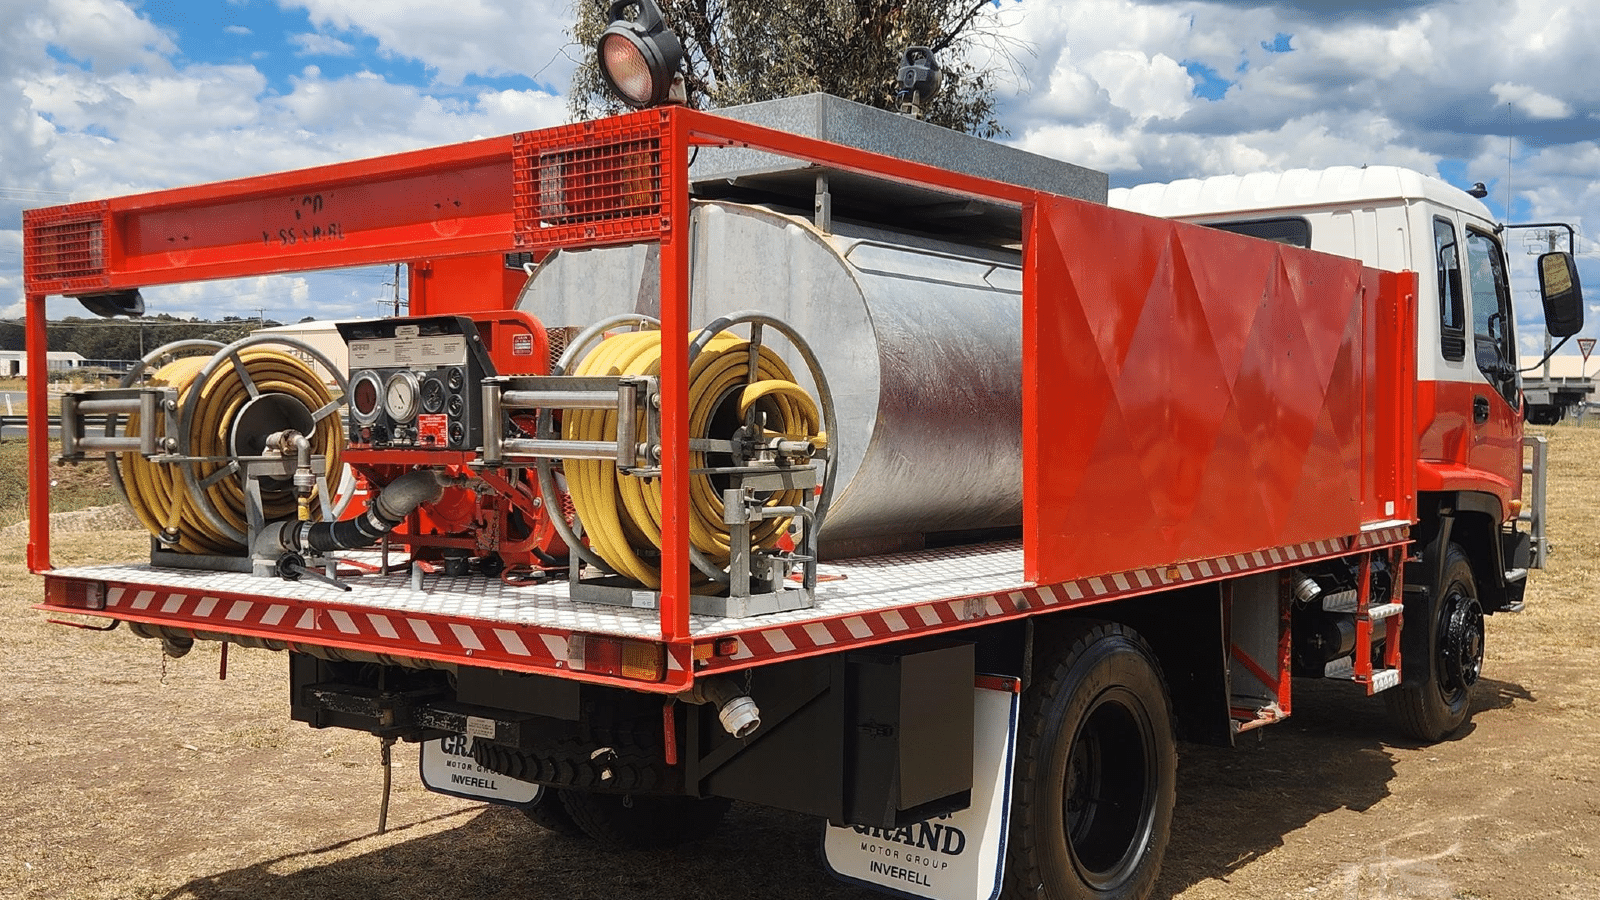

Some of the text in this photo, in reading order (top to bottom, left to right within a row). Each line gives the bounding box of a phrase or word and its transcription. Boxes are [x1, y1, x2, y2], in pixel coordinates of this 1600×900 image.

[446, 760, 472, 770] MOTOR
[451, 773, 498, 790] INVERELL
[861, 842, 948, 870] MOTOR GROUP
[870, 860, 931, 887] INVERELL
